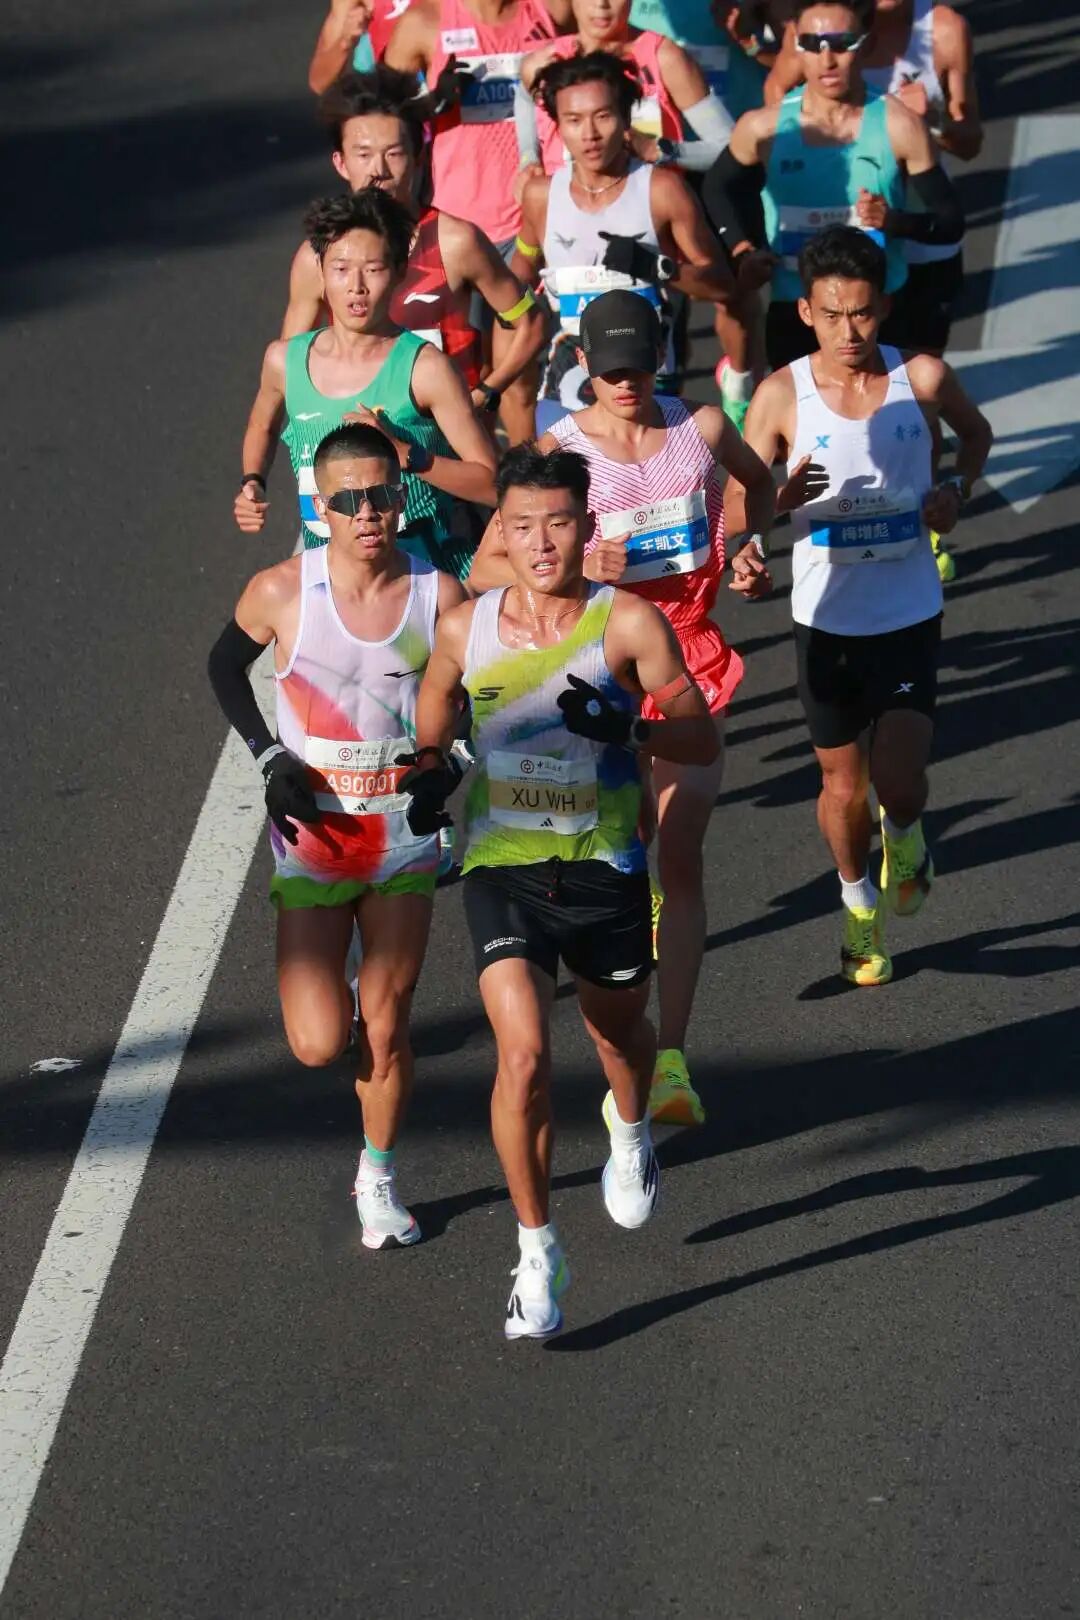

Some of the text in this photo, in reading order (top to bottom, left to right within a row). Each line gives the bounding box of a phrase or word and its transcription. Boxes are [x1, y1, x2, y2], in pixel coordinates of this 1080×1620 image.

[640, 532, 689, 554] 王凯文
[325, 772, 397, 795] A90001
[511, 787, 577, 812] XU WH
